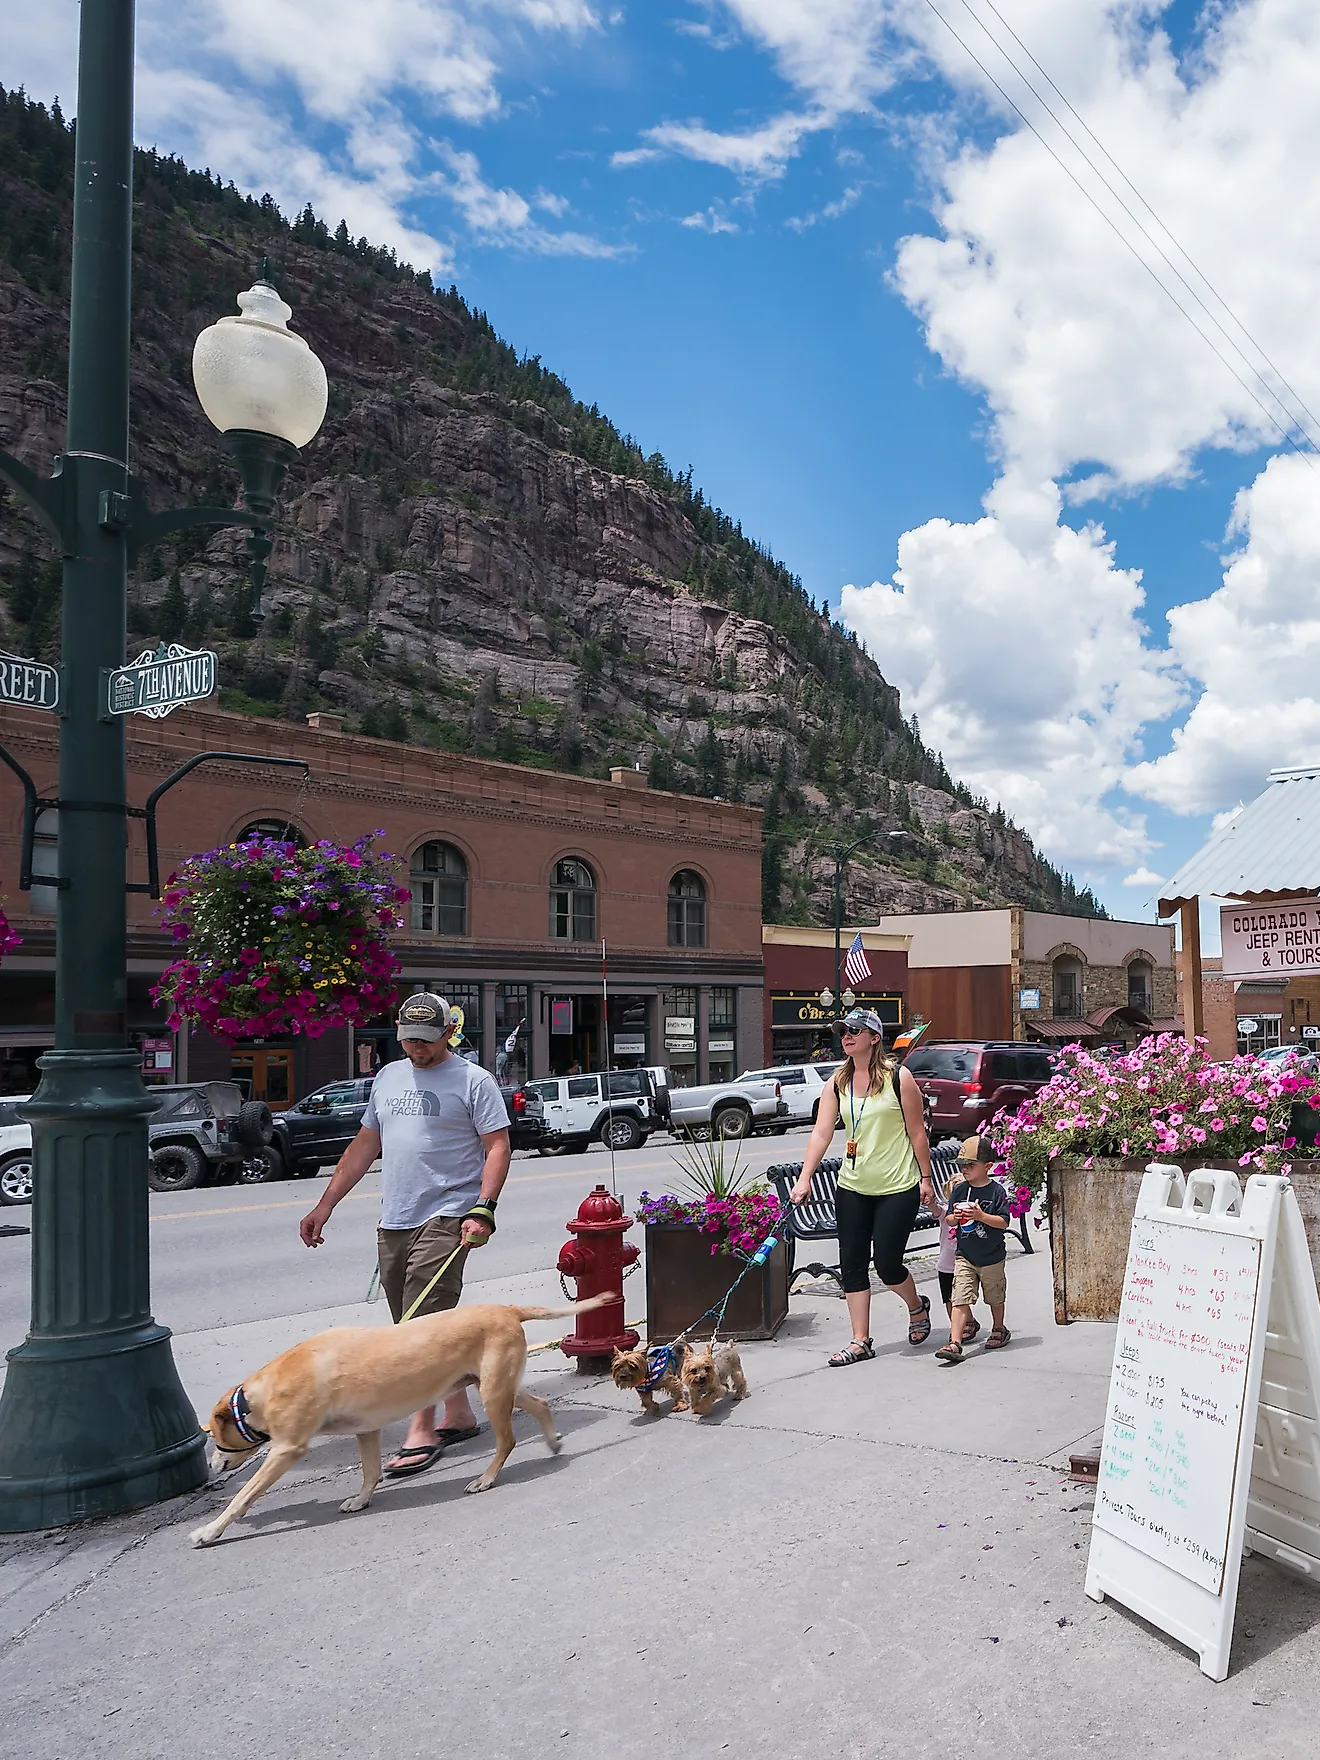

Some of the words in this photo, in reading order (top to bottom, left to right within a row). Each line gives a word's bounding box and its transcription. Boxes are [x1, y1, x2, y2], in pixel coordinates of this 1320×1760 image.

[137, 670, 160, 705] 7TH
[159, 656, 210, 701] AVENUE
[1233, 911, 1307, 933] COLORADO
[1246, 932, 1279, 950] JEEP
[1262, 951, 1272, 967] &
[403, 1090, 424, 1098] THE
[385, 1099, 422, 1107] NORTH
[391, 1107, 421, 1116] FACE
[1181, 1264, 1186, 1275] 3
[1178, 1284, 1183, 1295] 4
[1175, 1301, 1181, 1311] 4
[1179, 1329, 1188, 1340] for
[1111, 1445, 1117, 1457] 4
[1101, 1490, 1124, 1515] Private
[1126, 1503, 1146, 1526] Tours
